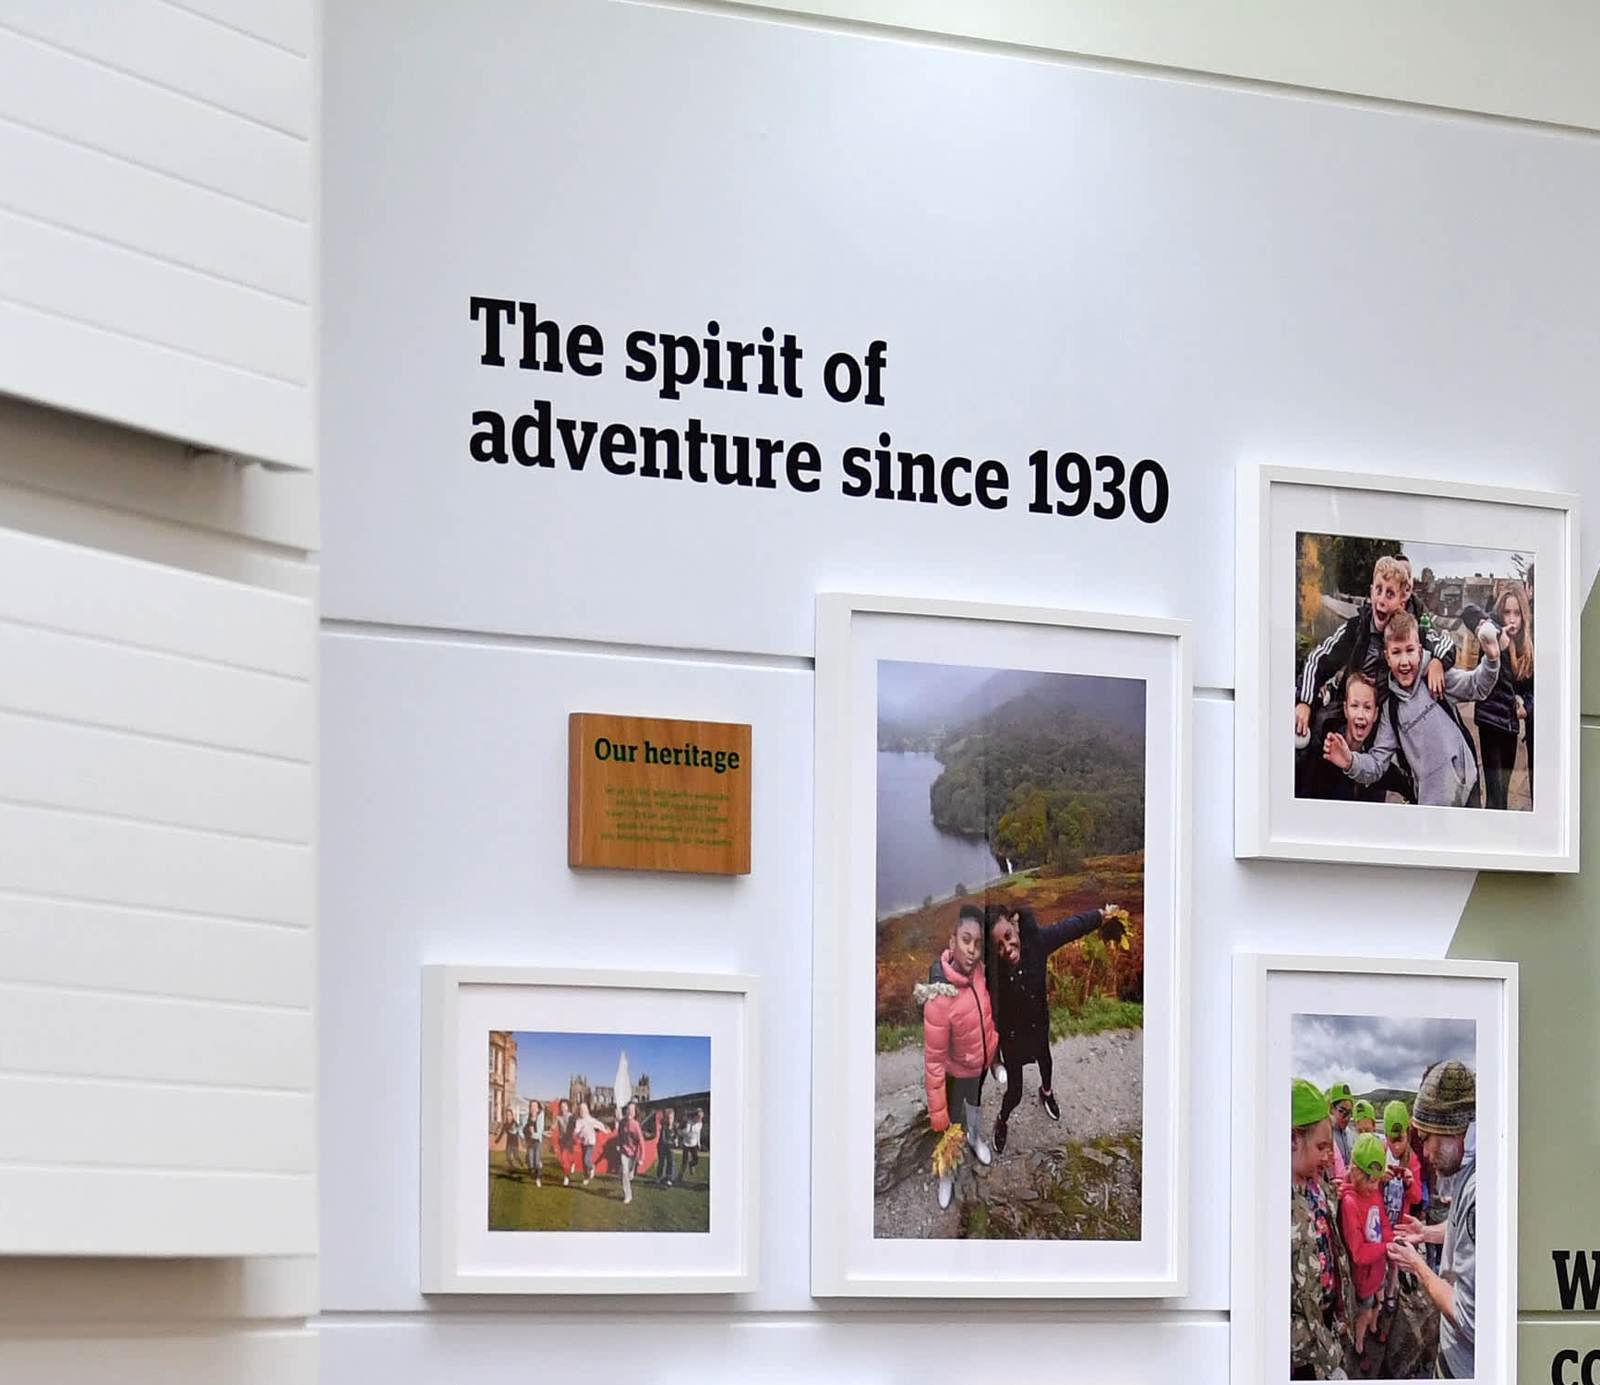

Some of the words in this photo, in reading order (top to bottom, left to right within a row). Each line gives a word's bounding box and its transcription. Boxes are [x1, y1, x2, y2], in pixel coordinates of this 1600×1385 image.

[470, 296, 604, 376] The
[625, 320, 803, 400] spirit
[823, 340, 887, 406] of
[469, 399, 823, 496] adventure
[842, 431, 1009, 510] since
[1028, 449, 1169, 524] 1930
[594, 737, 638, 763] Our
[644, 741, 740, 774] heritage
